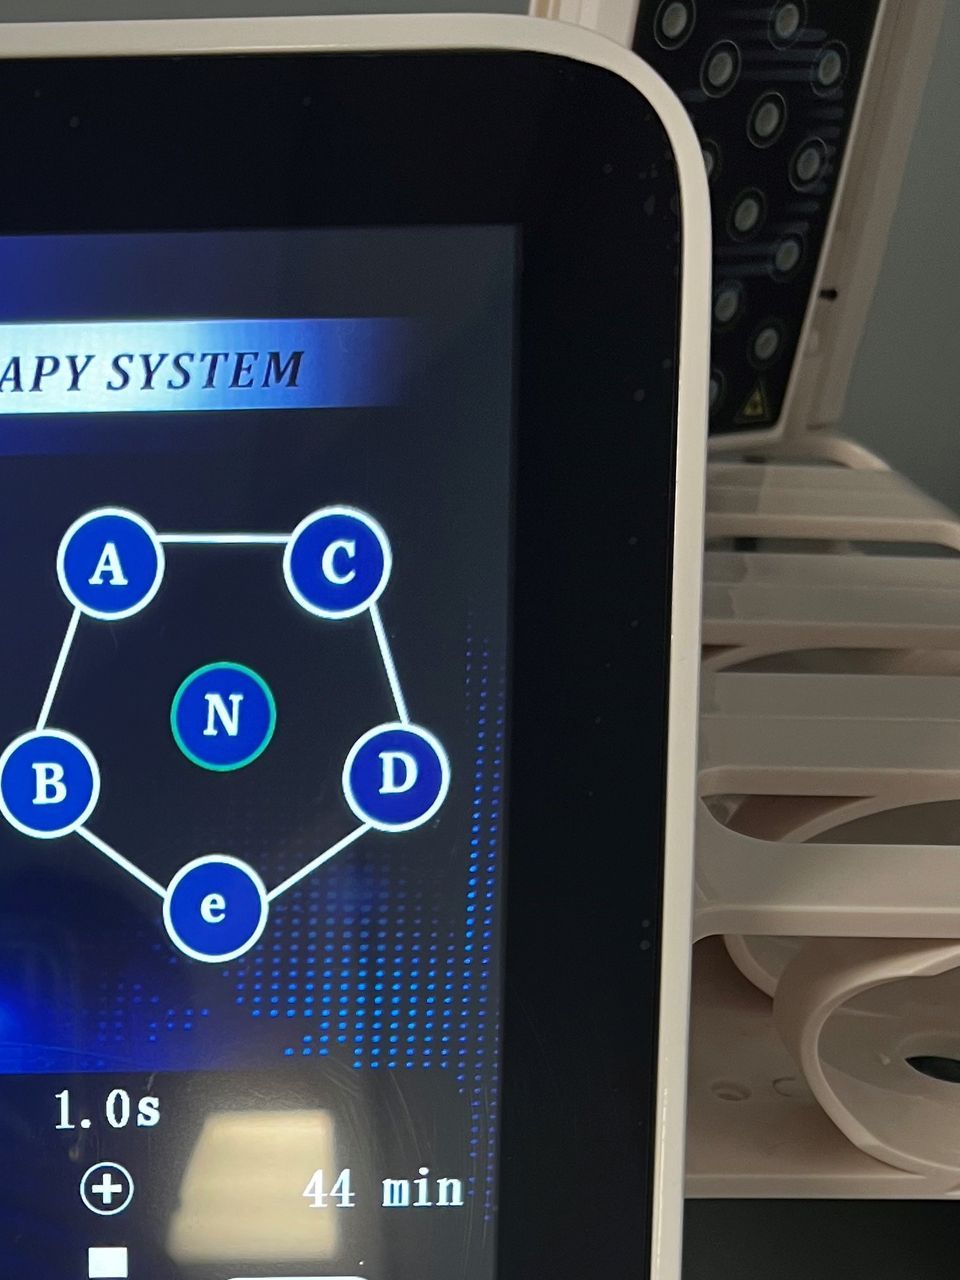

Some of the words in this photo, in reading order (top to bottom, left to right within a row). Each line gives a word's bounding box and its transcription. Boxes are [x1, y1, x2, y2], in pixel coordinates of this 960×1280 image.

[108, 349, 305, 392] SYSTEM
[88, 542, 129, 586] A
[321, 539, 356, 585] C
[202, 693, 244, 737] N
[31, 762, 67, 805] B
[378, 751, 418, 794] D
[200, 893, 226, 923] e
[54, 1088, 161, 1130] 1.0s
[302, 1169, 357, 1209] 44
[381, 1166, 464, 1207] min
